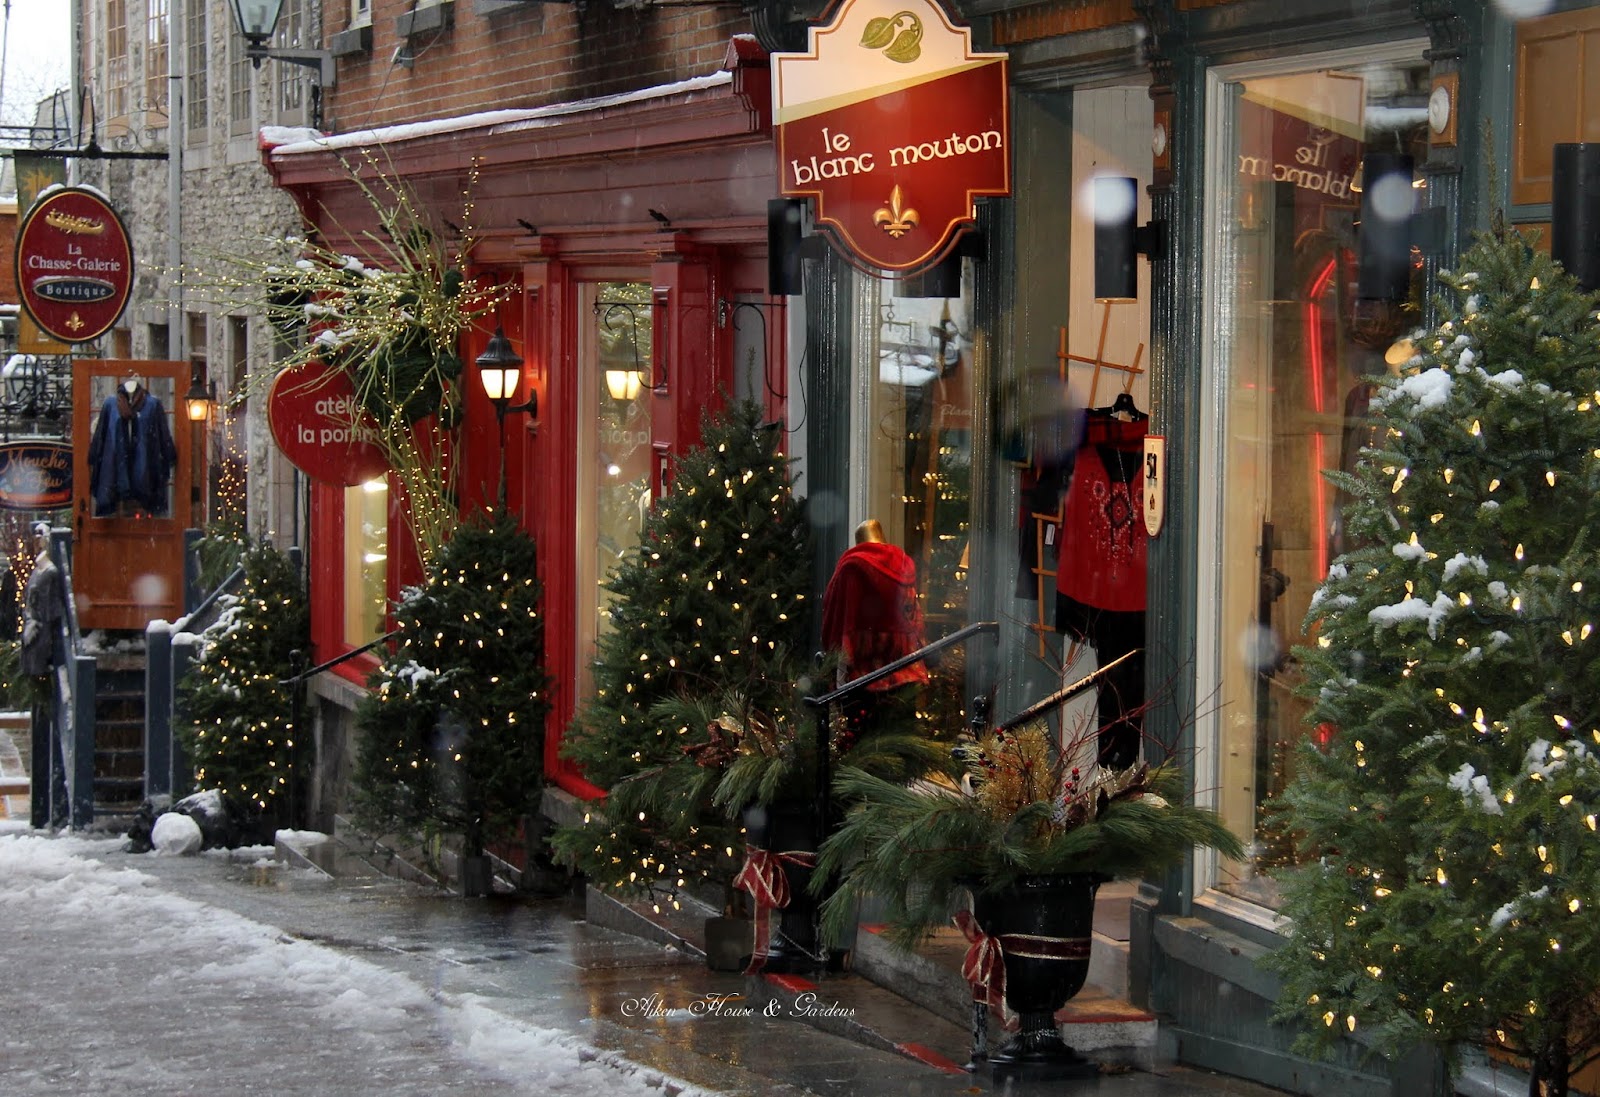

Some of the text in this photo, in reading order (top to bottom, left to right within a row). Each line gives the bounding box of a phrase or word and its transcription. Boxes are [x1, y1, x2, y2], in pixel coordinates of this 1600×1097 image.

[822, 127, 850, 153] le
[791, 130, 1002, 185] blanc mouton
[68, 243, 82, 255] La
[28, 255, 121, 271] Chasse-Galerie
[46, 285, 107, 297] Boutique
[298, 424, 315, 443] la
[0, 448, 68, 474] Mouche
